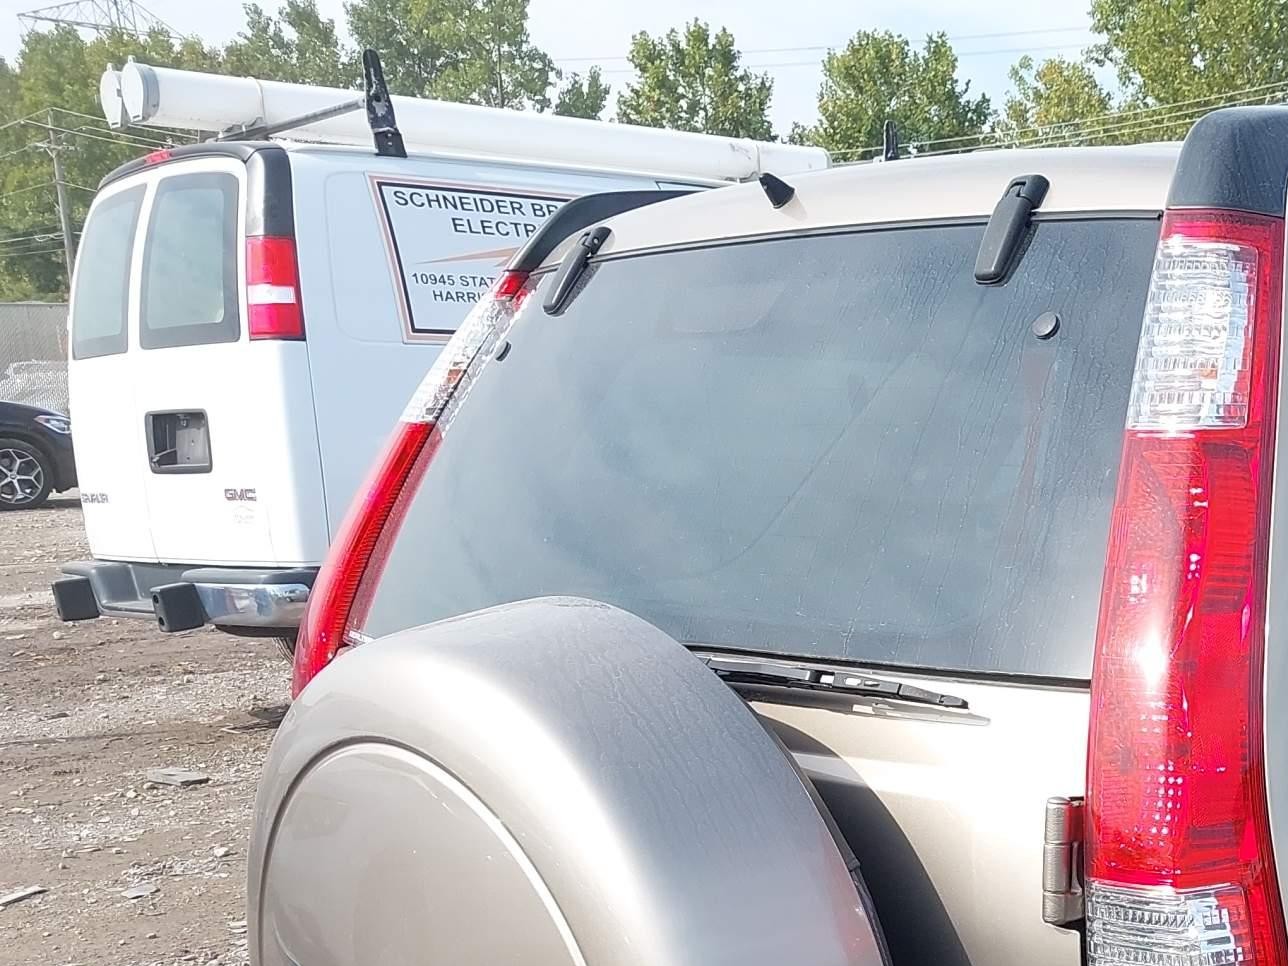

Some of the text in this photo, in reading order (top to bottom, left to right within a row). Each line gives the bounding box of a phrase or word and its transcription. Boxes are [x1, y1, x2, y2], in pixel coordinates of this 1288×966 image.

[393, 190, 526, 216] SCHNEIDER
[451, 217, 541, 238] ELECTR
[411, 272, 455, 286] 10945
[432, 290, 485, 303] HARRI
[224, 487, 257, 501] GMC
